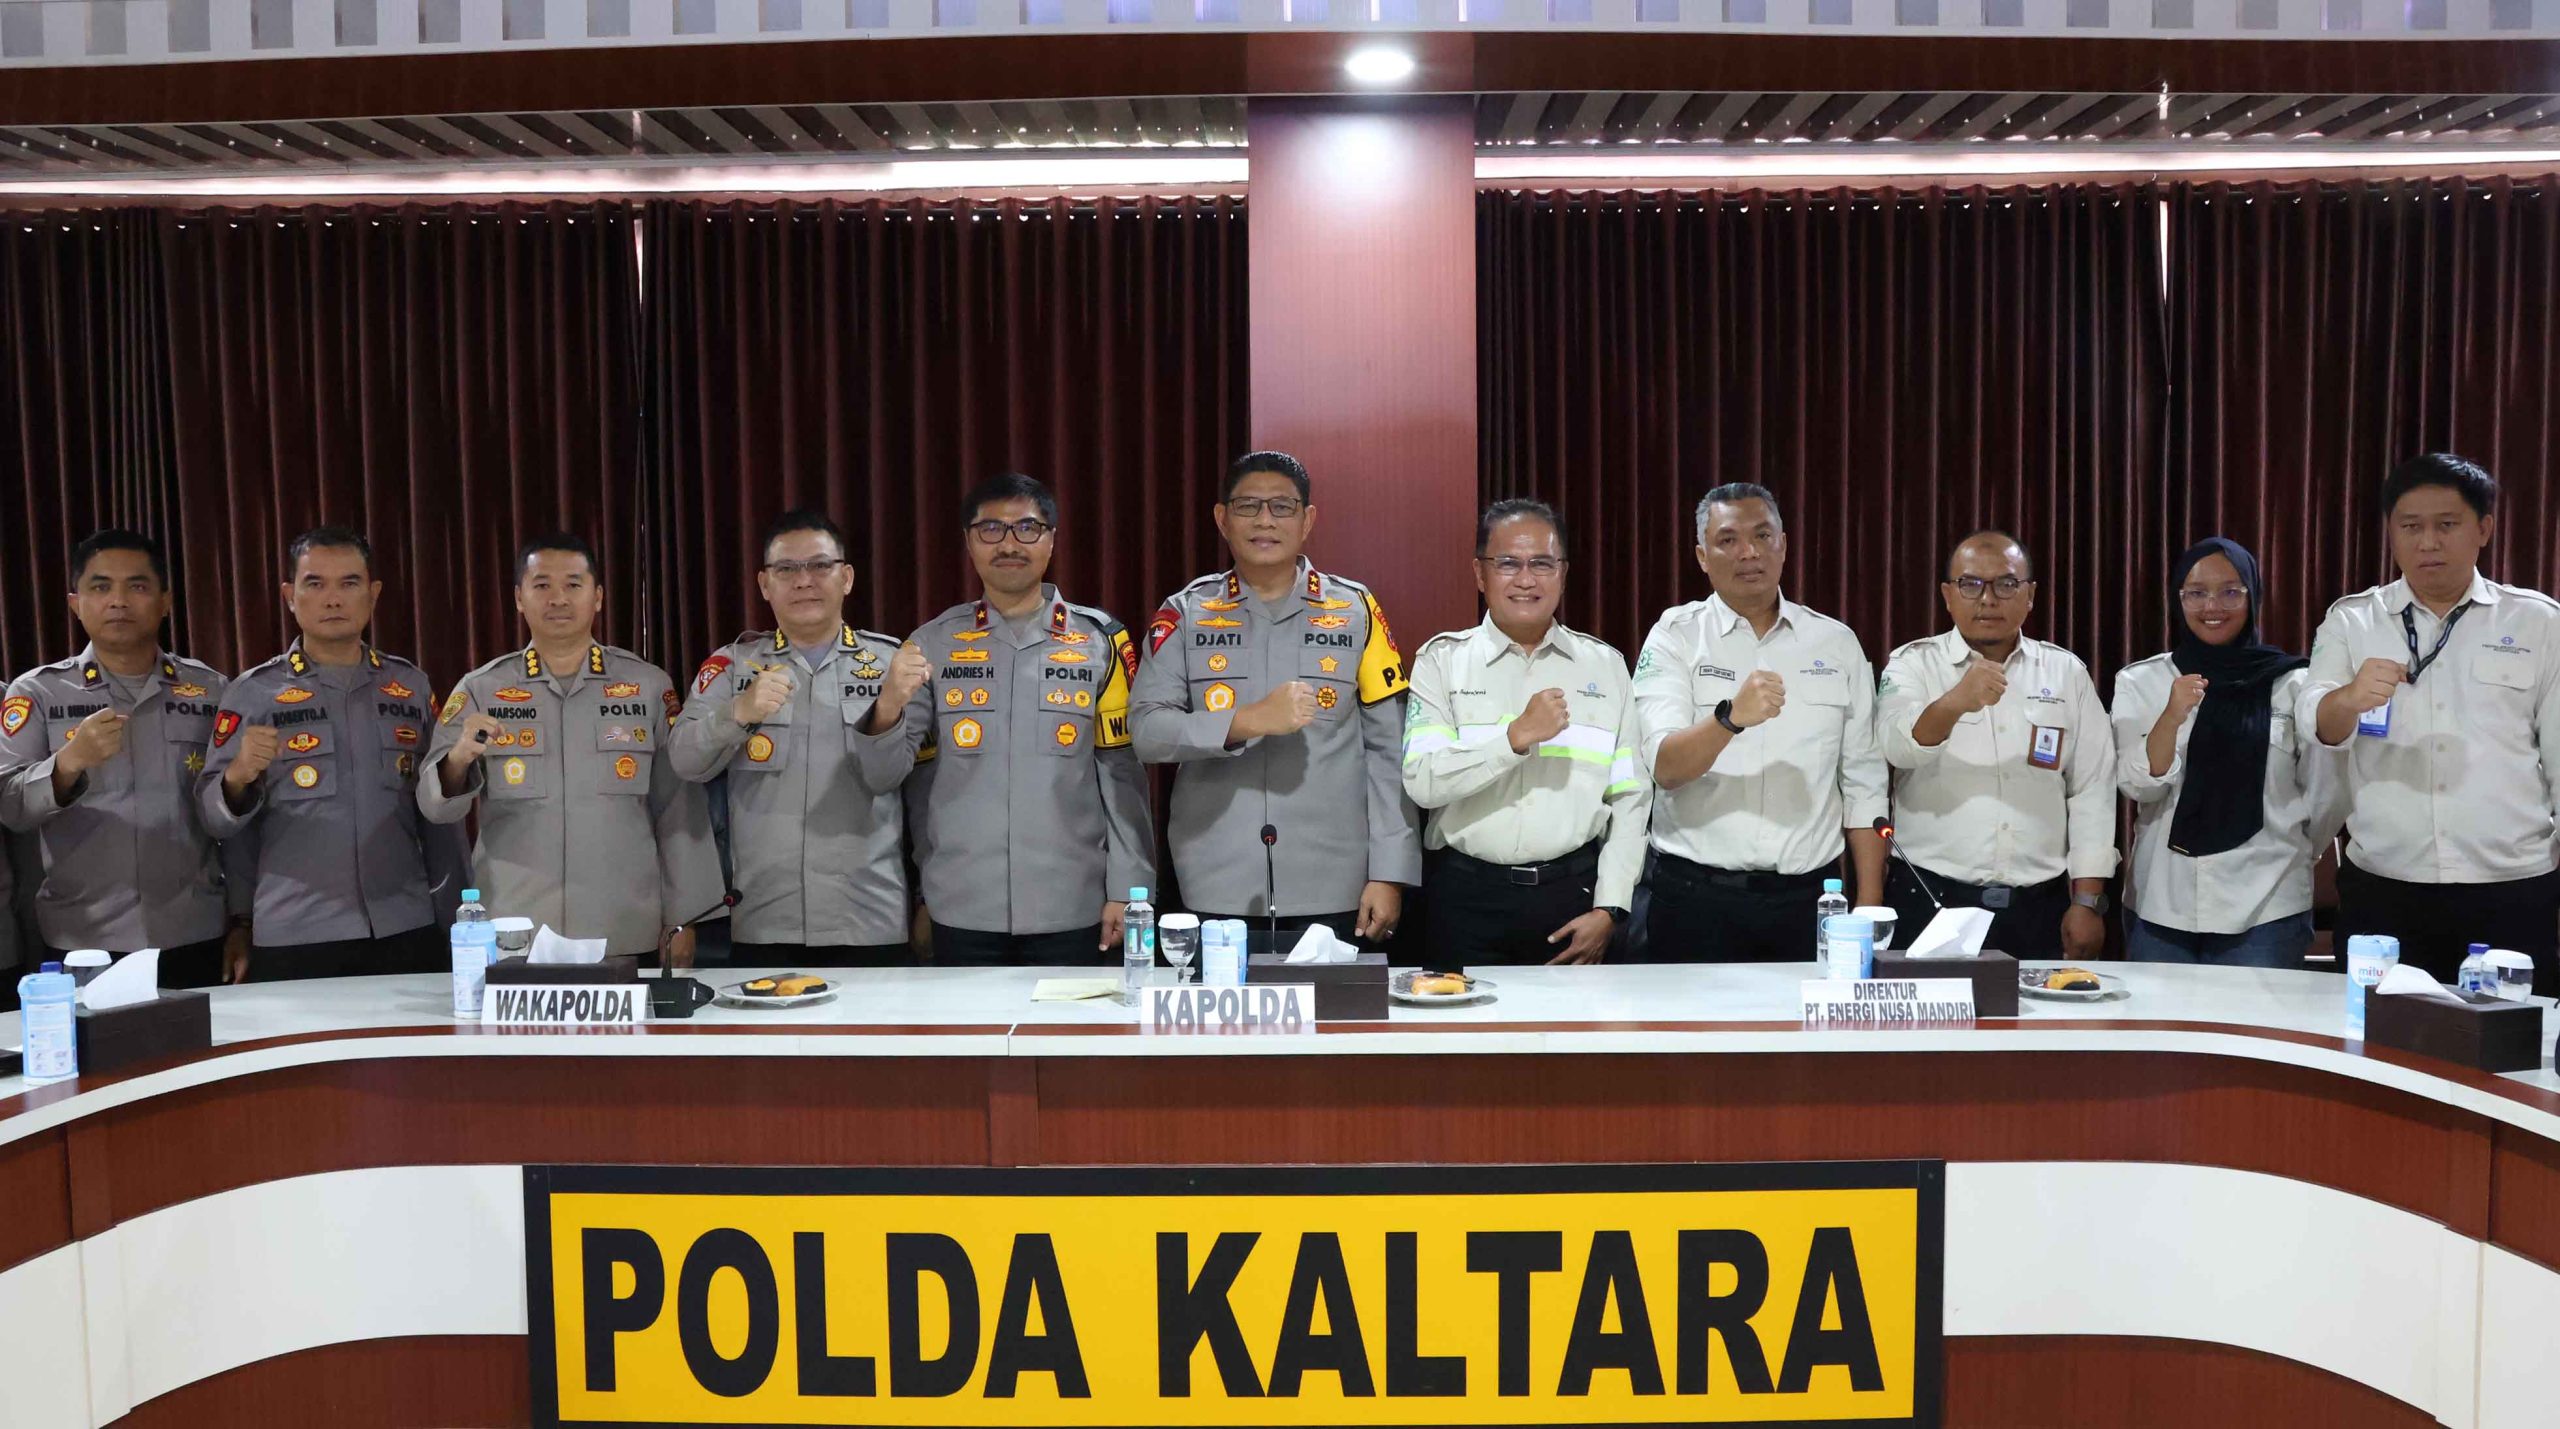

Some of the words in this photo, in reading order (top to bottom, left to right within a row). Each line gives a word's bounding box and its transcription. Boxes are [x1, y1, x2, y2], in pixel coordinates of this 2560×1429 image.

[1196, 633, 1242, 646] DJATI
[1304, 633, 1353, 648] POLRI
[941, 666, 984, 679] ANDRIES
[986, 666, 994, 679] H
[1045, 667, 1093, 682] POLRI
[844, 685, 883, 697] POL
[165, 701, 219, 717] POLRI
[378, 703, 422, 720] POLRI
[488, 707, 537, 719] WARSONO
[600, 703, 647, 717] POLRI
[1854, 983, 1918, 1001] DIREKTUR
[496, 990, 633, 1021] WAKAPOLDA
[1154, 988, 1302, 1024] KAPOLDA
[1804, 1003, 1825, 1021] PT.
[1828, 1002, 1876, 1021] ENERGI
[1879, 1002, 1915, 1021] NUSA
[1917, 1002, 1974, 1021] MANDIRI
[581, 1227, 1092, 1398] POLDA
[1156, 1227, 1885, 1397] KALTARA
